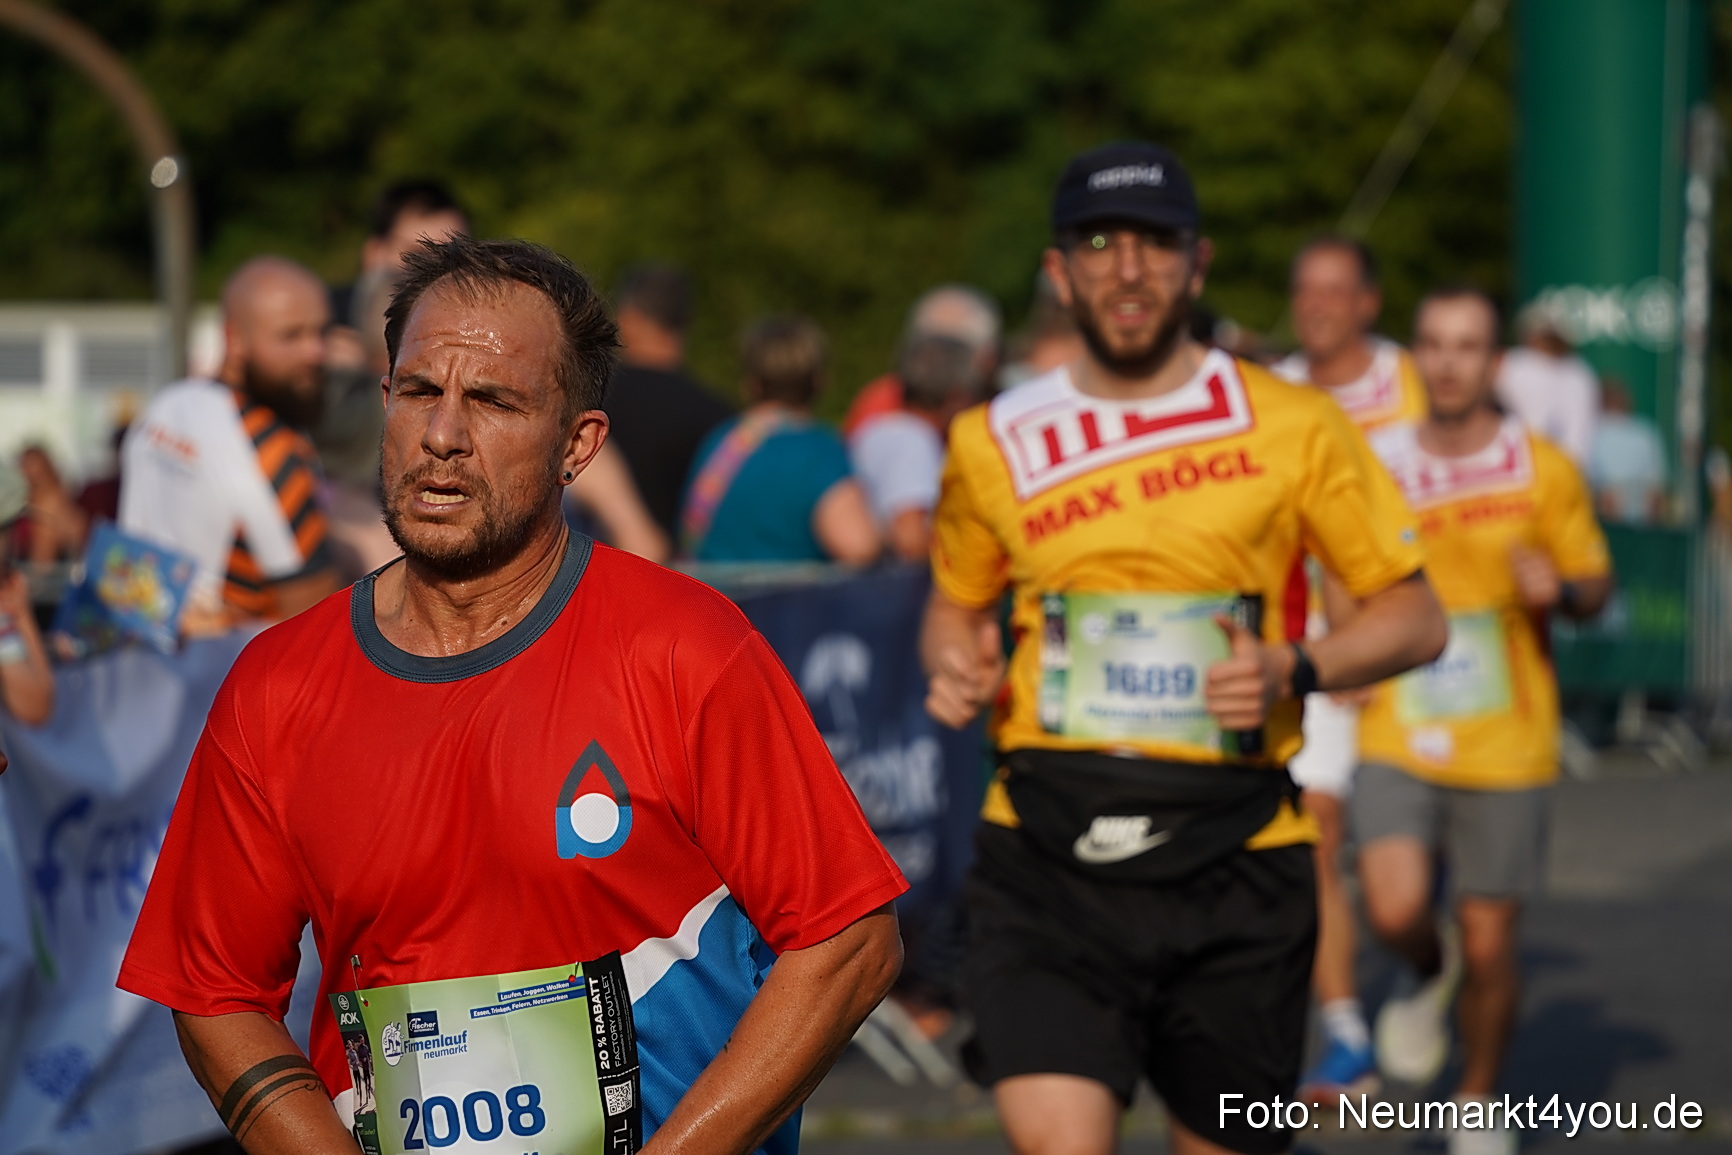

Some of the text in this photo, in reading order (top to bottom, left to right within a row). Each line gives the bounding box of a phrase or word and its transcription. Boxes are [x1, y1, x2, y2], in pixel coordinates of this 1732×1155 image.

[1023, 449, 1265, 543] MAX BÖGL
[1105, 664, 1196, 698] 1689
[1090, 815, 1152, 844] NIKE
[546, 982, 569, 991] Walken
[601, 975, 615, 1017] OUTLET
[340, 1012, 360, 1025] AOK
[409, 1018, 436, 1031] Fischer
[589, 977, 610, 1070] 20 % RABATT
[403, 1030, 467, 1054] Firmenlauf
[424, 1044, 467, 1060] neumarkt
[608, 1019, 621, 1067] FACTORY
[400, 1084, 546, 1150] 2008
